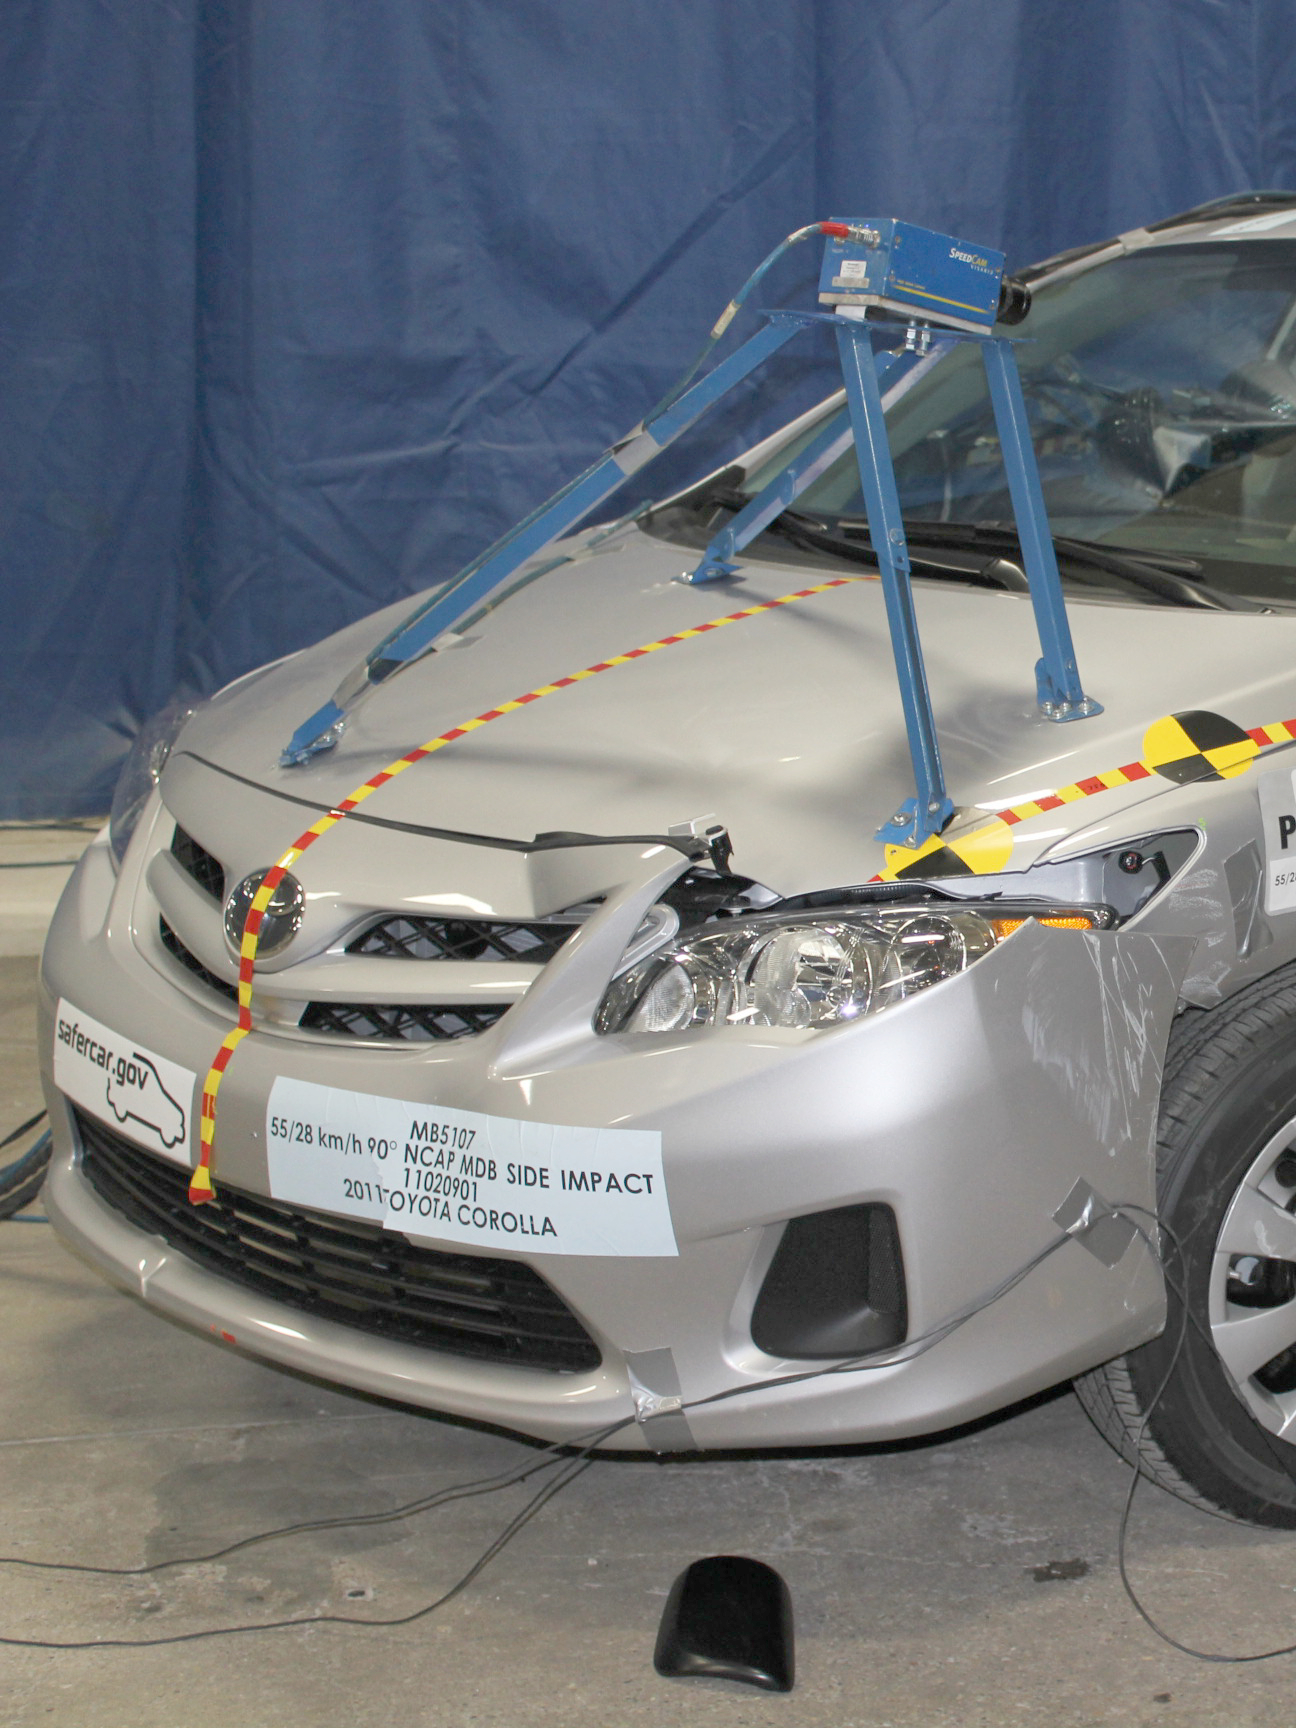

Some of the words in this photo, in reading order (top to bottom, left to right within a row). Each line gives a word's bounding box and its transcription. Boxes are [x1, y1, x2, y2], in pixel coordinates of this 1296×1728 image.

[58, 1019, 148, 1090] safercar.gov
[271, 1116, 313, 1144] 55/28
[318, 1126, 363, 1155] km/h
[404, 1143, 455, 1171] NCAP
[459, 1154, 497, 1181] MDB
[507, 1162, 550, 1189] SIDE
[561, 1169, 654, 1195] IMPACT
[410, 1120, 476, 1150] MB5107
[343, 1178, 383, 1204] 2011
[457, 1204, 558, 1237] COROLLA
[403, 1167, 478, 1202] 11020901
